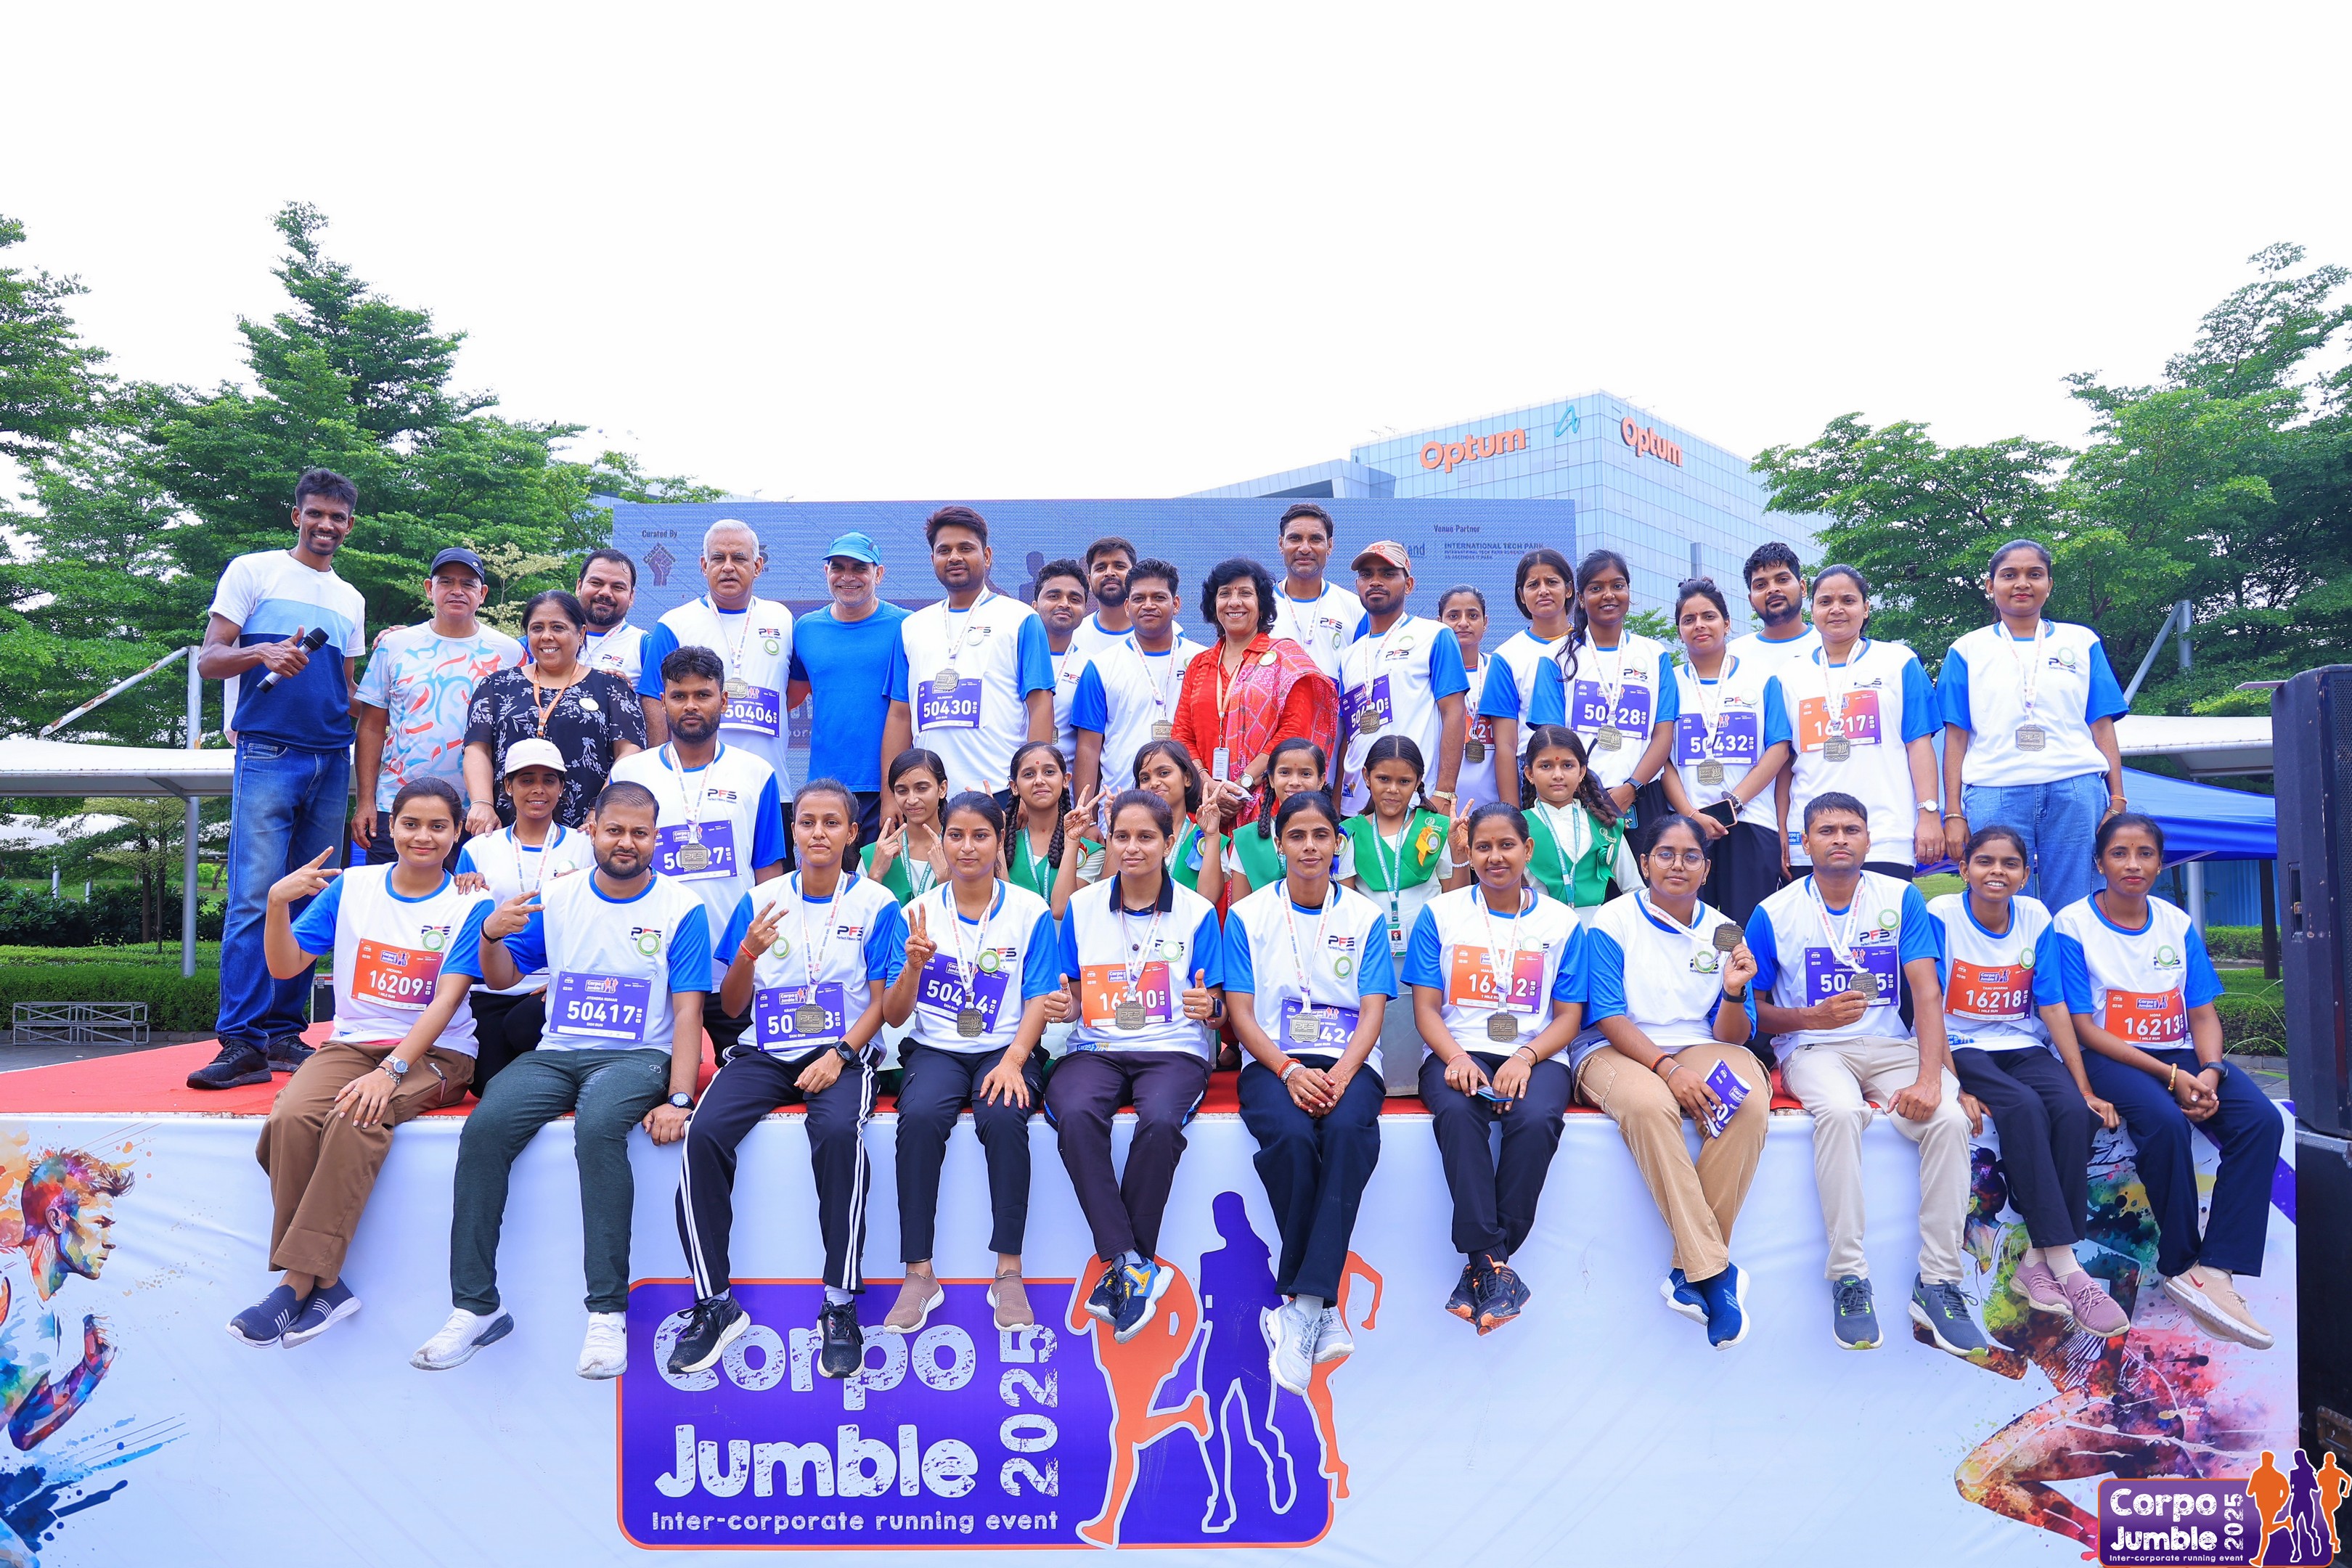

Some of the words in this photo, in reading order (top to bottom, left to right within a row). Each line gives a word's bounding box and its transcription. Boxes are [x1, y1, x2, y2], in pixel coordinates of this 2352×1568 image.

[1419, 427, 1525, 473] Optum
[1622, 417, 1683, 467] Optum
[669, 530, 677, 539] By
[1320, 618, 1342, 629] PFS
[724, 704, 772, 724] 50406
[923, 700, 971, 718] 50430
[1584, 703, 1641, 725] 5028
[708, 789, 737, 799] PFS
[1538, 806, 1553, 832] EDUCATIONAL
[1172, 833, 1183, 857] EDUCATIONAL
[1550, 830, 1560, 849] PARDADI
[1025, 841, 1034, 865] EDUCATIONAL
[1555, 849, 1568, 870] PARDADA
[918, 871, 929, 891] PARDADI
[1382, 866, 1391, 887] PARDADA
[1646, 905, 1657, 914] Corpo
[1657, 910, 1670, 921] Jumble
[1328, 936, 1355, 947] PFS
[1826, 926, 1834, 939] Corpo
[1860, 929, 1890, 942] PFS
[369, 970, 424, 996] 16209
[1099, 989, 1157, 1011] 1610
[1966, 990, 2021, 1008] 16218
[567, 1000, 636, 1024] 50417
[2125, 1015, 2180, 1036] 16213
[653, 1307, 976, 1411] Corpo
[1000, 1324, 1059, 1498] 2025
[654, 1424, 979, 1498] Jumble
[652, 1511, 865, 1535] Inter-corporate
[876, 1511, 974, 1535] running
[987, 1512, 1059, 1530] event
